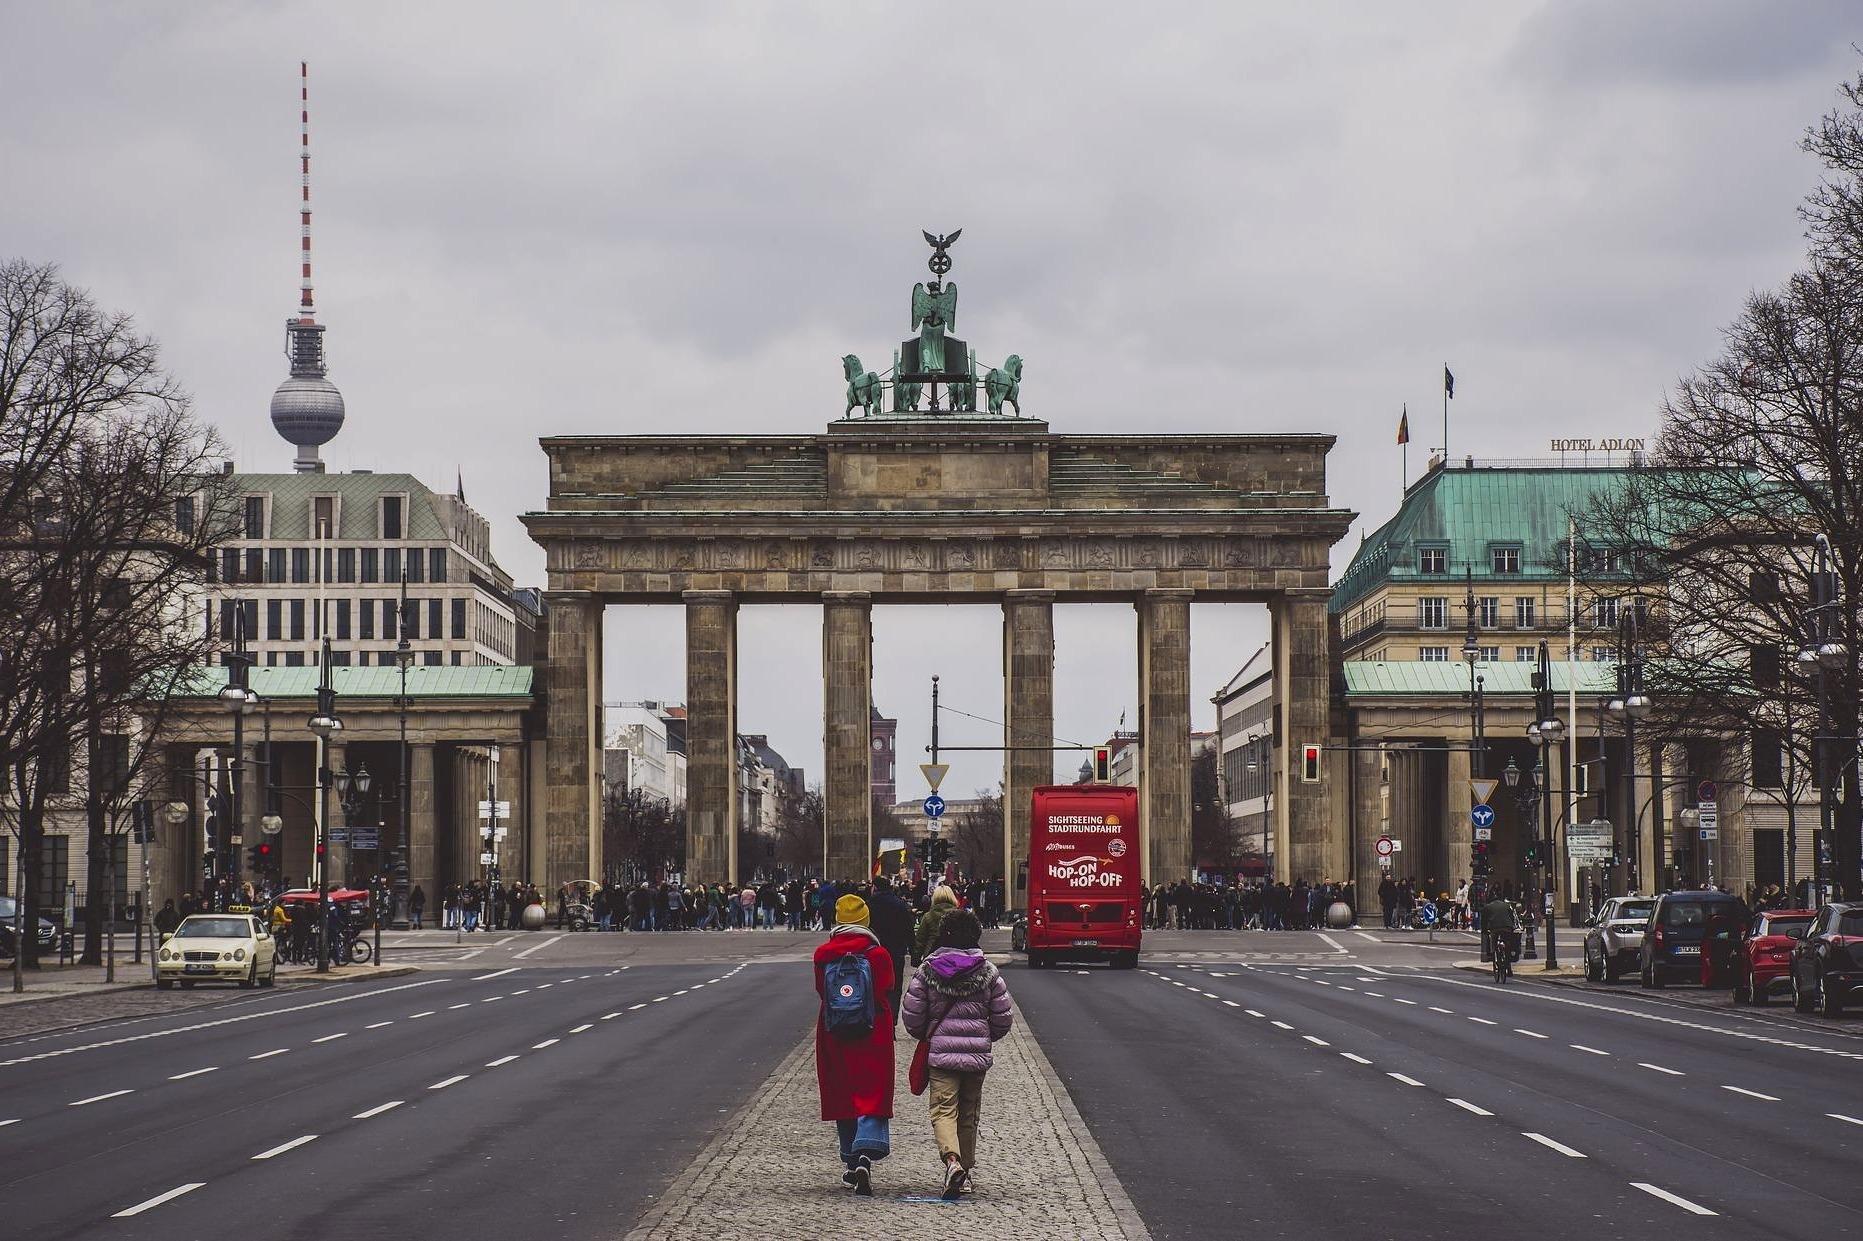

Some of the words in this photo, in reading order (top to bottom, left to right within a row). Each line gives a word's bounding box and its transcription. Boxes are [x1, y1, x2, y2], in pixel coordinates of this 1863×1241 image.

[1551, 439, 1595, 451] HOTEL
[1599, 438, 1645, 451] ADLON
[1048, 815, 1103, 824] SIGHTSEEING
[1048, 825, 1122, 833] STADTRUNDFAHRT
[1048, 862, 1097, 879] HOP-ON
[1070, 872, 1123, 887] HOP-OFF
